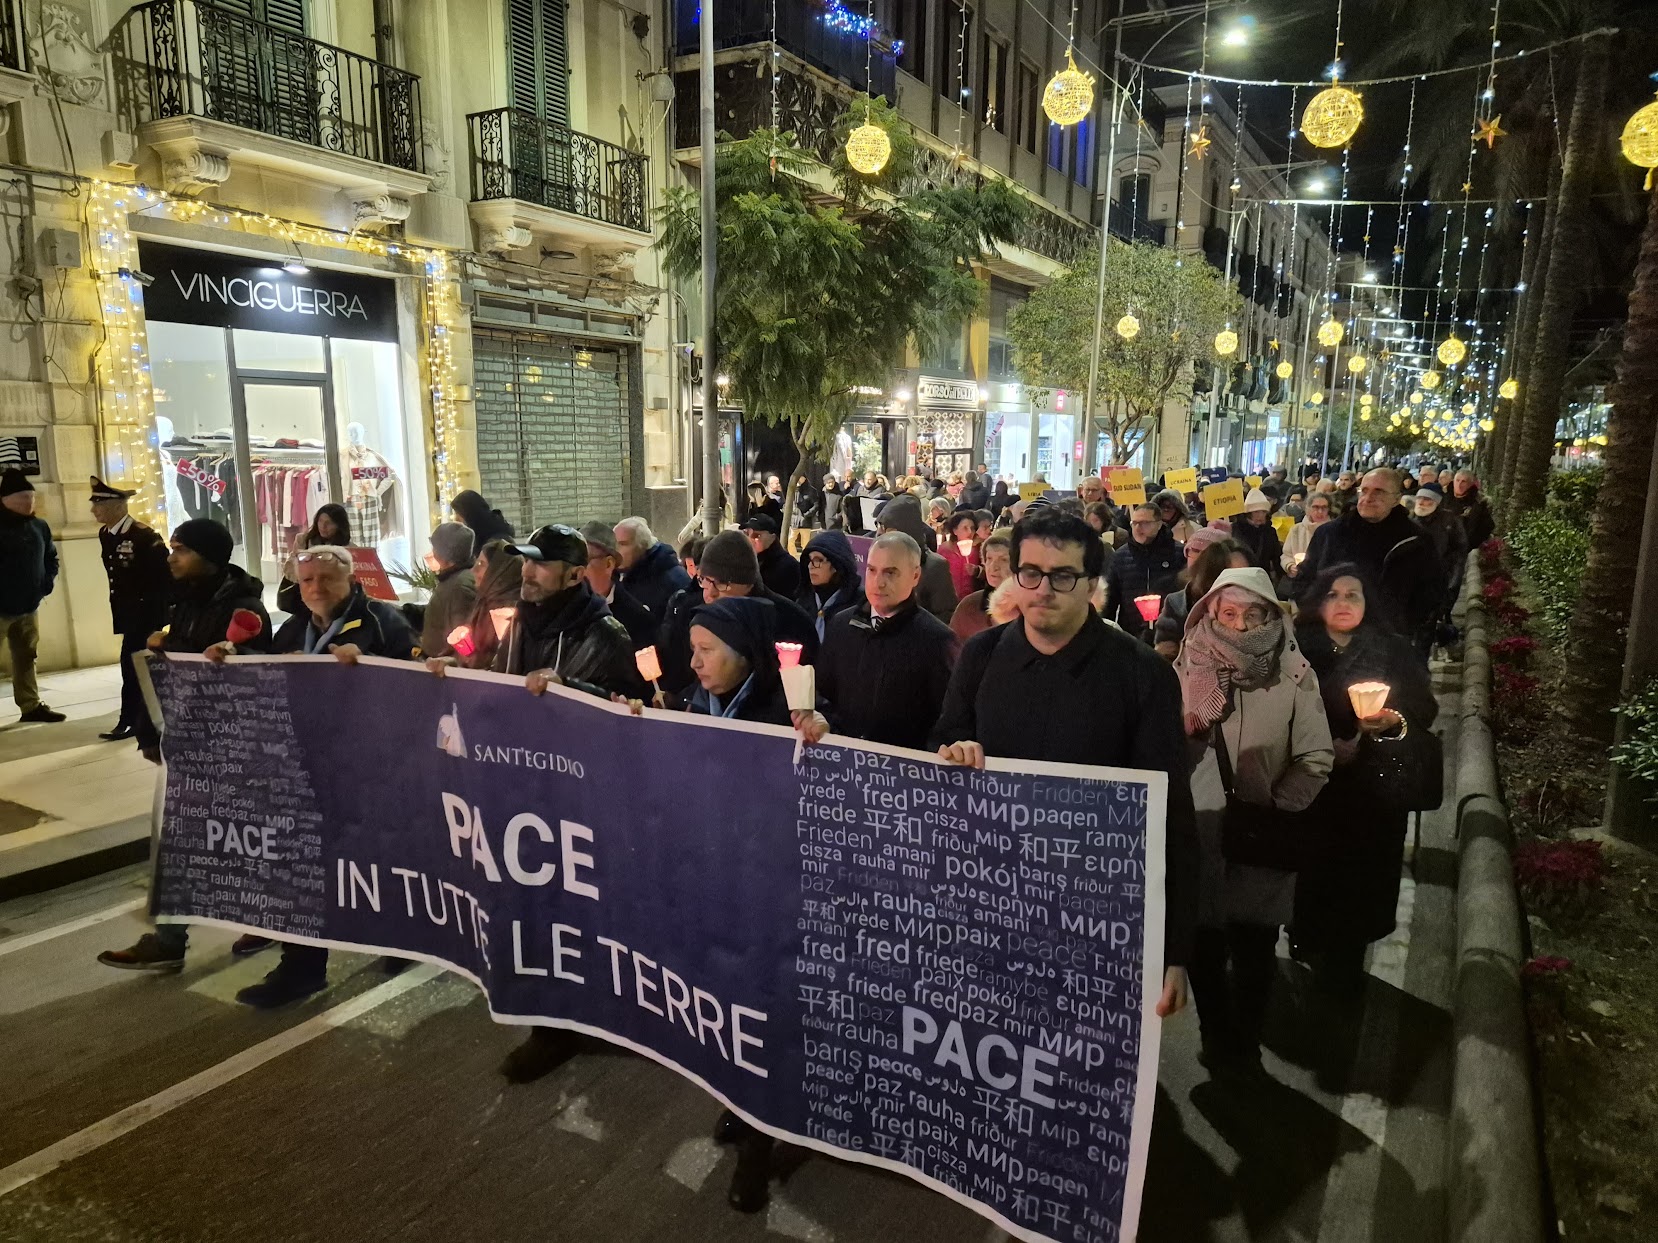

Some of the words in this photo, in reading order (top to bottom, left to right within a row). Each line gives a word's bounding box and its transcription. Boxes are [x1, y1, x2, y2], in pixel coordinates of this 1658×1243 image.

[171, 270, 368, 320] VINCIGUERRA
[180, 464, 222, 491] -50%
[353, 467, 386, 479] -50%
[1213, 494, 1236, 505] ETIOPIA
[185, 774, 210, 793] fred
[474, 744, 585, 779] SANT'EGIDIO
[853, 750, 892, 770] paz
[899, 762, 964, 787] rauha
[970, 771, 1022, 798] friður
[869, 771, 897, 788] mir
[801, 782, 846, 801] vrede
[862, 783, 907, 811] fred
[913, 787, 958, 811] paix
[967, 793, 1030, 832] Мир
[1034, 807, 1098, 830] paqen
[206, 818, 279, 860] PACE
[442, 791, 599, 901] PACE
[797, 819, 873, 850] Frieden
[883, 843, 936, 864] amani
[932, 829, 979, 856] friður
[798, 796, 857, 824] friede
[864, 807, 922, 846] 平和
[924, 809, 968, 832] cisza
[1019, 832, 1082, 869] 和平
[800, 841, 842, 862] cisza
[852, 853, 896, 871] rauha
[946, 854, 1018, 896] pokój
[1020, 861, 1067, 892] barış
[1074, 876, 1114, 894] friður
[800, 873, 835, 895] paz
[802, 858, 829, 874] mir
[902, 863, 930, 880] mir
[1024, 883, 1055, 902] mir
[797, 917, 847, 938] amani
[803, 899, 836, 922] 平和
[843, 909, 890, 931] vrede
[895, 914, 952, 949] Мир
[956, 923, 1001, 950] paix
[1007, 931, 1087, 969] peace
[873, 891, 936, 919] rauha
[973, 907, 1030, 933] amani
[1060, 910, 1131, 950] Мир
[337, 859, 380, 912] IN
[391, 867, 491, 970] TUTTE
[512, 920, 584, 984] LE
[597, 935, 768, 1078] TERRE
[802, 935, 846, 963] fred
[855, 929, 910, 965] fred
[916, 945, 979, 979] friede
[796, 956, 836, 983] barış
[921, 966, 964, 992] paix
[968, 984, 1017, 1015] pokój
[798, 984, 855, 1021] 平和
[859, 1002, 895, 1025] paz
[848, 973, 907, 1003] friede
[914, 980, 958, 1014] fred
[959, 1000, 999, 1028] paz
[1004, 1017, 1035, 1039] mir
[1062, 969, 1118, 1004] 和平
[837, 1021, 898, 1050] rauha
[902, 1005, 1059, 1110] PACE
[1039, 1026, 1105, 1072] Мир
[1075, 1022, 1116, 1044] amani
[803, 1032, 863, 1075] barış
[868, 1054, 922, 1082] peace
[972, 1085, 1033, 1137] 平和
[805, 1061, 854, 1085] peace
[864, 1073, 902, 1097] paz
[909, 1090, 965, 1130] rauha
[970, 1117, 1018, 1151] friður
[878, 1096, 906, 1114] mir
[1059, 1071, 1120, 1105] Fridden
[806, 1117, 863, 1150] friede
[927, 1144, 967, 1175] cisza
[1011, 1188, 1071, 1231] 和平
[808, 1100, 853, 1123] vrede
[871, 1107, 914, 1139] fred
[919, 1119, 958, 1151] paix
[967, 1138, 1024, 1184] Мир
[1027, 1167, 1088, 1198] paqen
